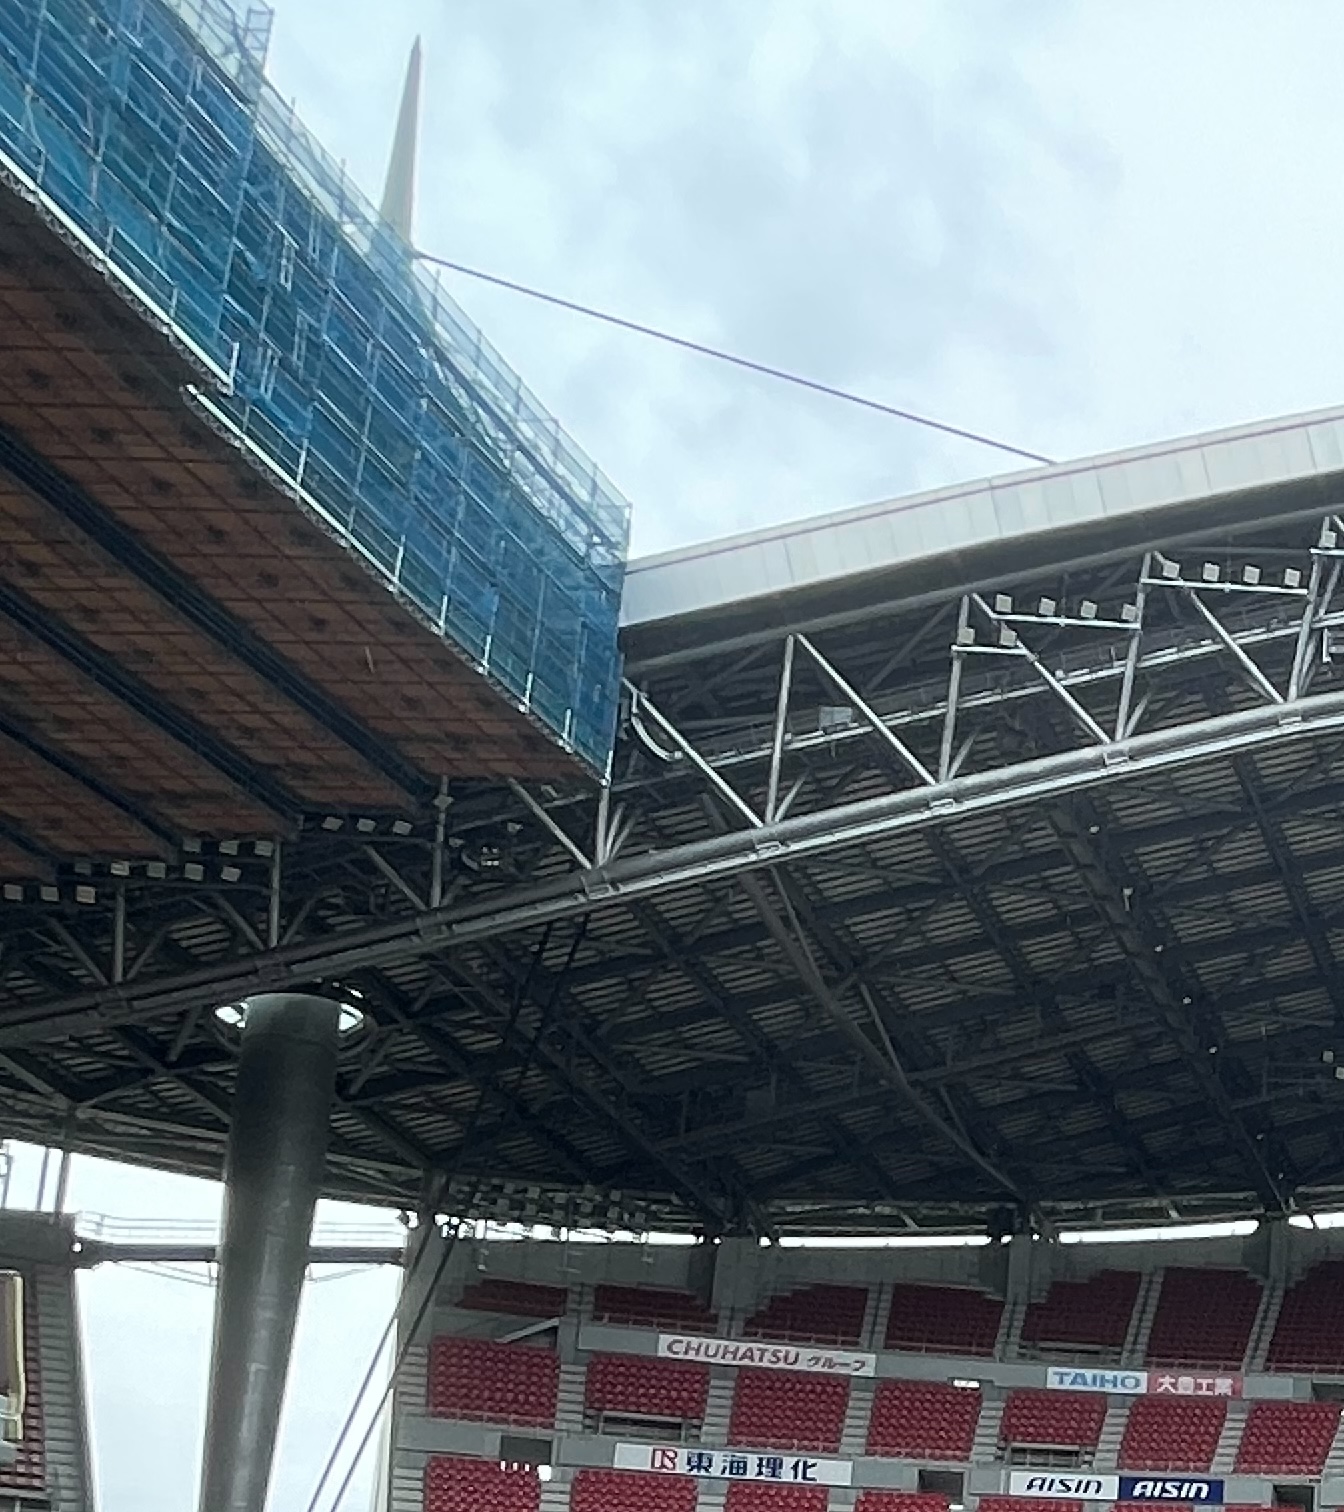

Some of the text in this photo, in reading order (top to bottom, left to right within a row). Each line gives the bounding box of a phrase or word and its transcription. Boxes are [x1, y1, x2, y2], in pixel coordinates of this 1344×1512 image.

[666, 1338, 799, 1368] CHUHATSU
[1053, 1371, 1141, 1390] TAIHO
[686, 1452, 818, 1482] 東海理化
[1025, 1476, 1102, 1494] AISIN
[1132, 1480, 1209, 1498] AISIN
